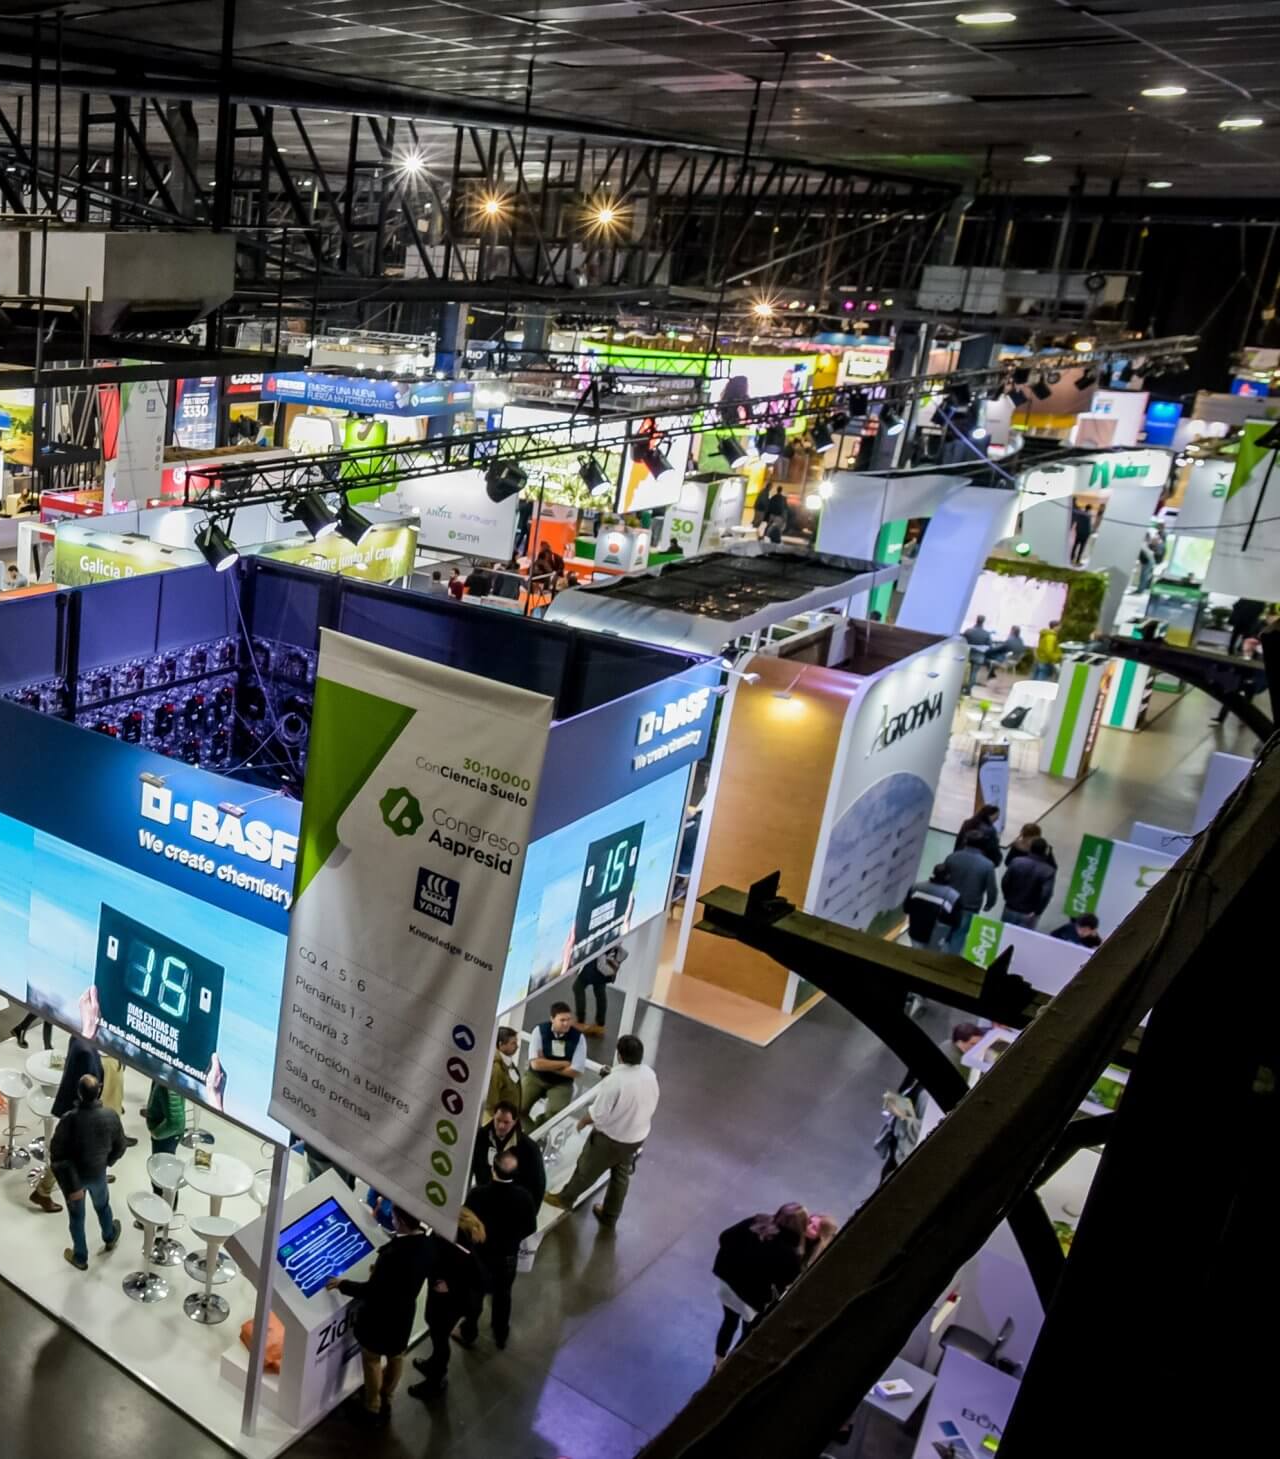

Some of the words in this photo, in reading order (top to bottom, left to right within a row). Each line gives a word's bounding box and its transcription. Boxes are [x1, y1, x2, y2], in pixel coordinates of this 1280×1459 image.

[182, 405, 209, 418] 3330
[671, 518, 694, 535] 30
[80, 555, 121, 578] Galicia
[661, 688, 710, 735] BASF
[415, 756, 488, 793] ConCiencia
[489, 783, 528, 807] Suelo
[462, 757, 531, 792] 30:10000
[190, 800, 300, 870] BASF
[428, 829, 513, 876] Aapresid
[432, 808, 521, 856] Congreso
[138, 829, 164, 854] We
[164, 844, 216, 875] create
[216, 864, 294, 911] chemistry
[418, 898, 450, 921] YARA
[299, 946, 318, 965] CQ
[320, 960, 329, 972] 4
[338, 968, 347, 982] 5
[357, 979, 367, 993] 6
[408, 923, 463, 956] Knowledge
[463, 951, 494, 972] grows
[143, 1011, 170, 1037] EXTRAS
[170, 1025, 180, 1041] DE
[292, 1003, 338, 1041] Plenaria
[340, 1032, 350, 1047] 3
[295, 975, 347, 1015] Plenarias
[349, 1006, 356, 1020] 1
[365, 1015, 375, 1030] 2
[127, 1013, 180, 1055] PERSISTENCIA
[141, 1040, 173, 1064] eficacia
[285, 1059, 309, 1083] Sala
[311, 1077, 326, 1095] de
[329, 1089, 371, 1122] prensa
[288, 1031, 351, 1080] Inscripción
[353, 1074, 362, 1086] a
[365, 1078, 410, 1115] talleres
[282, 1086, 318, 1119] Baños
